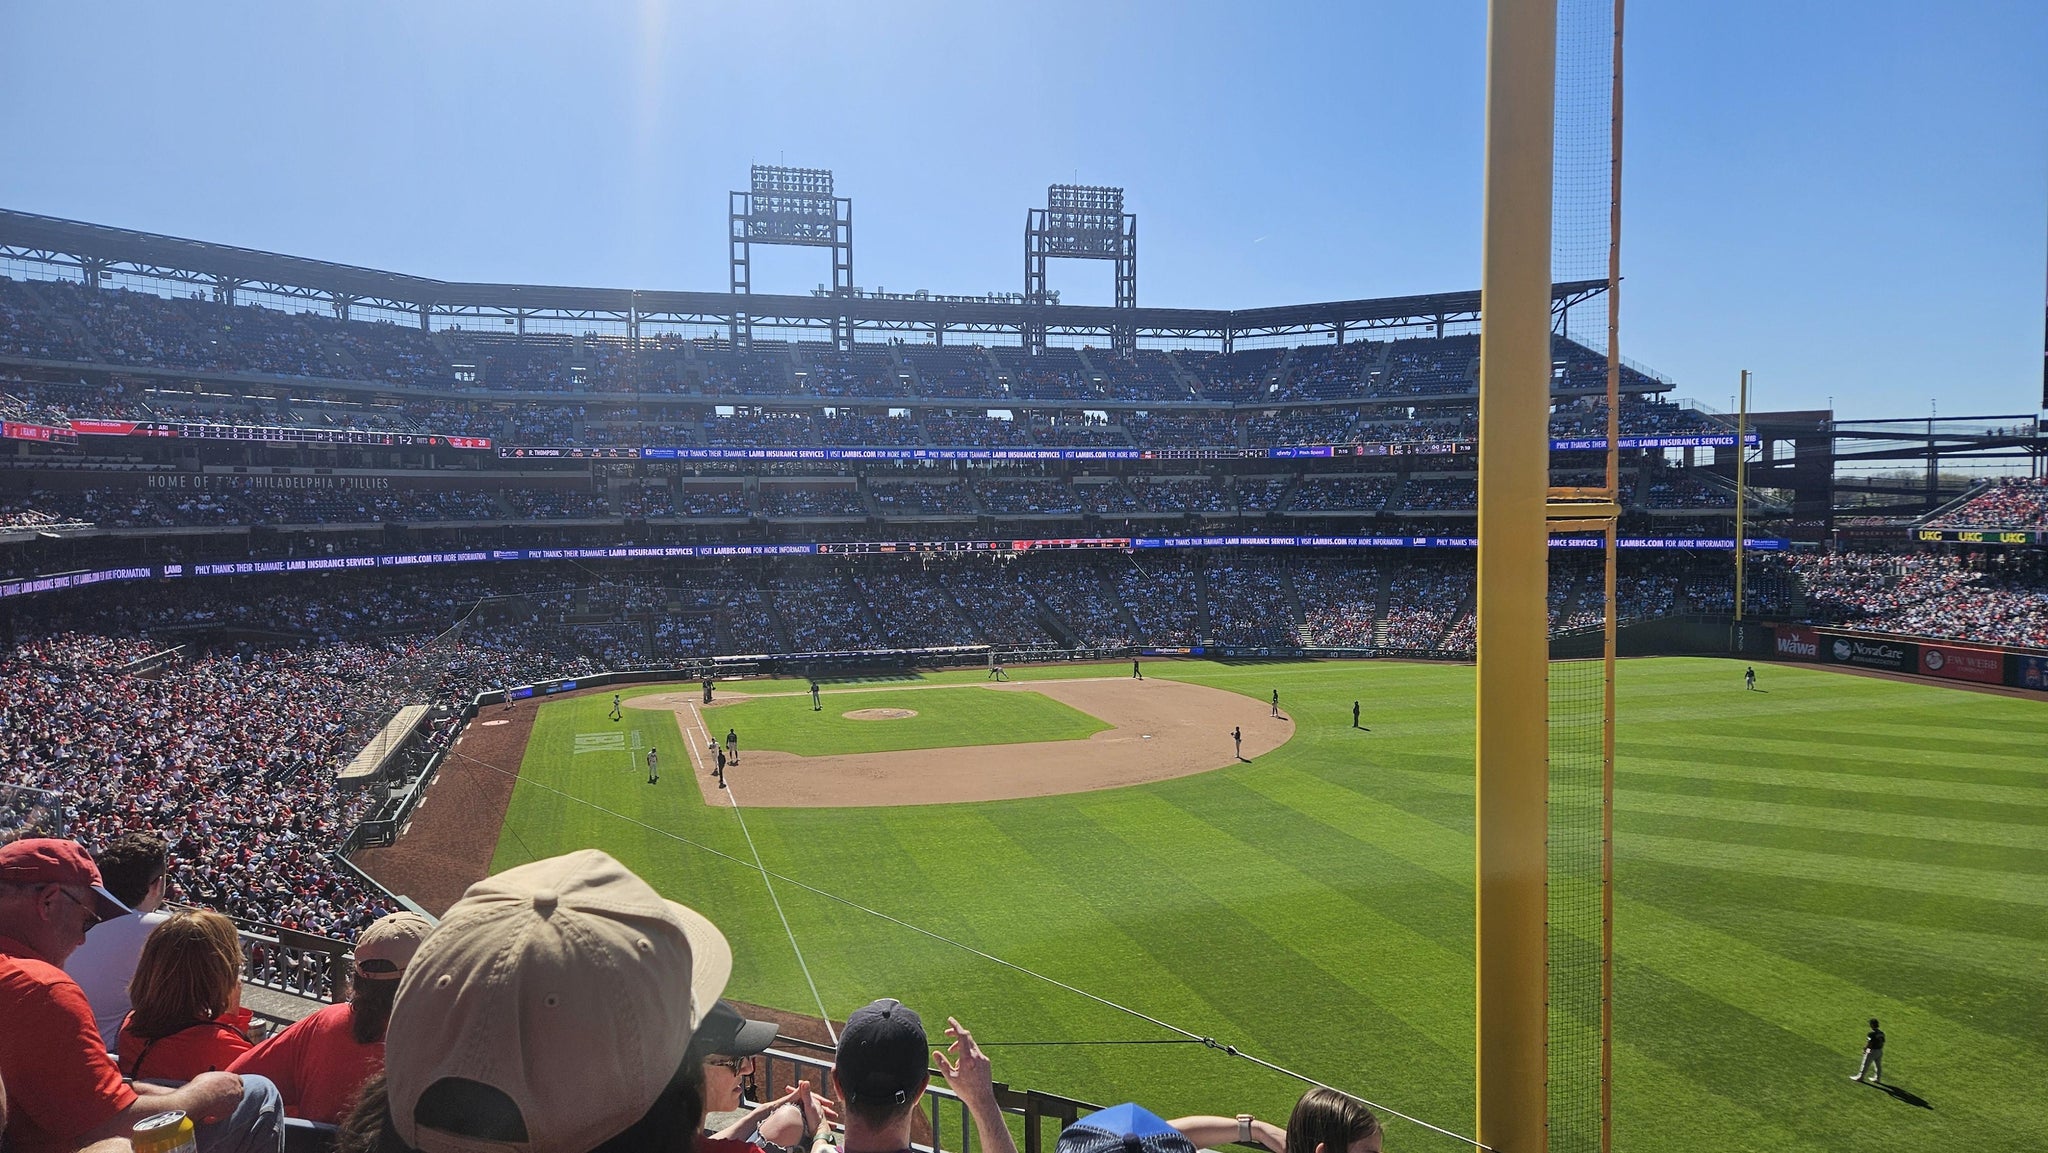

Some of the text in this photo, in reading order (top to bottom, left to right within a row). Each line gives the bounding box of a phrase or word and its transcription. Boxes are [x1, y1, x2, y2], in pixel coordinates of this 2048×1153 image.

[398, 436, 412, 445] 1-2
[1570, 441, 1591, 449] THANKS
[1591, 440, 1607, 448] THEIR
[1639, 439, 1658, 447] LAMB
[1660, 438, 1700, 447] INSURANCE
[1701, 437, 1734, 445] SERVICES
[766, 450, 798, 458] INSURANCE
[799, 450, 824, 458] SERVICES
[842, 450, 876, 458] LAMBIS.COM
[1008, 451, 1037, 459] INSURANCE
[148, 475, 186, 488] HOME
[194, 476, 209, 488] OF
[340, 477, 389, 489] PHILLIES
[1240, 537, 1270, 545] INSURANCE
[1373, 538, 1403, 546] INFORMATION
[1919, 531, 1942, 541] UKG
[1958, 531, 1983, 542] UKG
[2000, 532, 2026, 543] UKG
[954, 542, 972, 551] 1-2
[1568, 539, 1598, 547] SERVICES
[1620, 539, 1664, 547] LAMBIS.COM
[1678, 539, 1695, 547] MORE
[1696, 539, 1734, 548] INFORMATION
[528, 550, 542, 558] PHLY
[543, 550, 563, 558] THANKS
[564, 550, 578, 558] THEIR
[579, 549, 607, 557] TEAMMATE:
[608, 549, 627, 557] LAMB
[628, 548, 664, 556] INSURANCE
[665, 547, 693, 556] SERVICES
[700, 547, 712, 555] VISIT
[713, 547, 752, 555] LAMBIS.COM
[763, 546, 778, 554] MORE
[195, 552, 487, 575] PHLY THANKS THEIR TEAMMATE: LAMB INSURANCE SERVICES VISIT LAMBIS.COM FOR MORE INFORMATION
[1777, 638, 1817, 656] Wawa
[1852, 642, 1904, 659] NovaCare
[1968, 657, 1997, 670] WEBB
